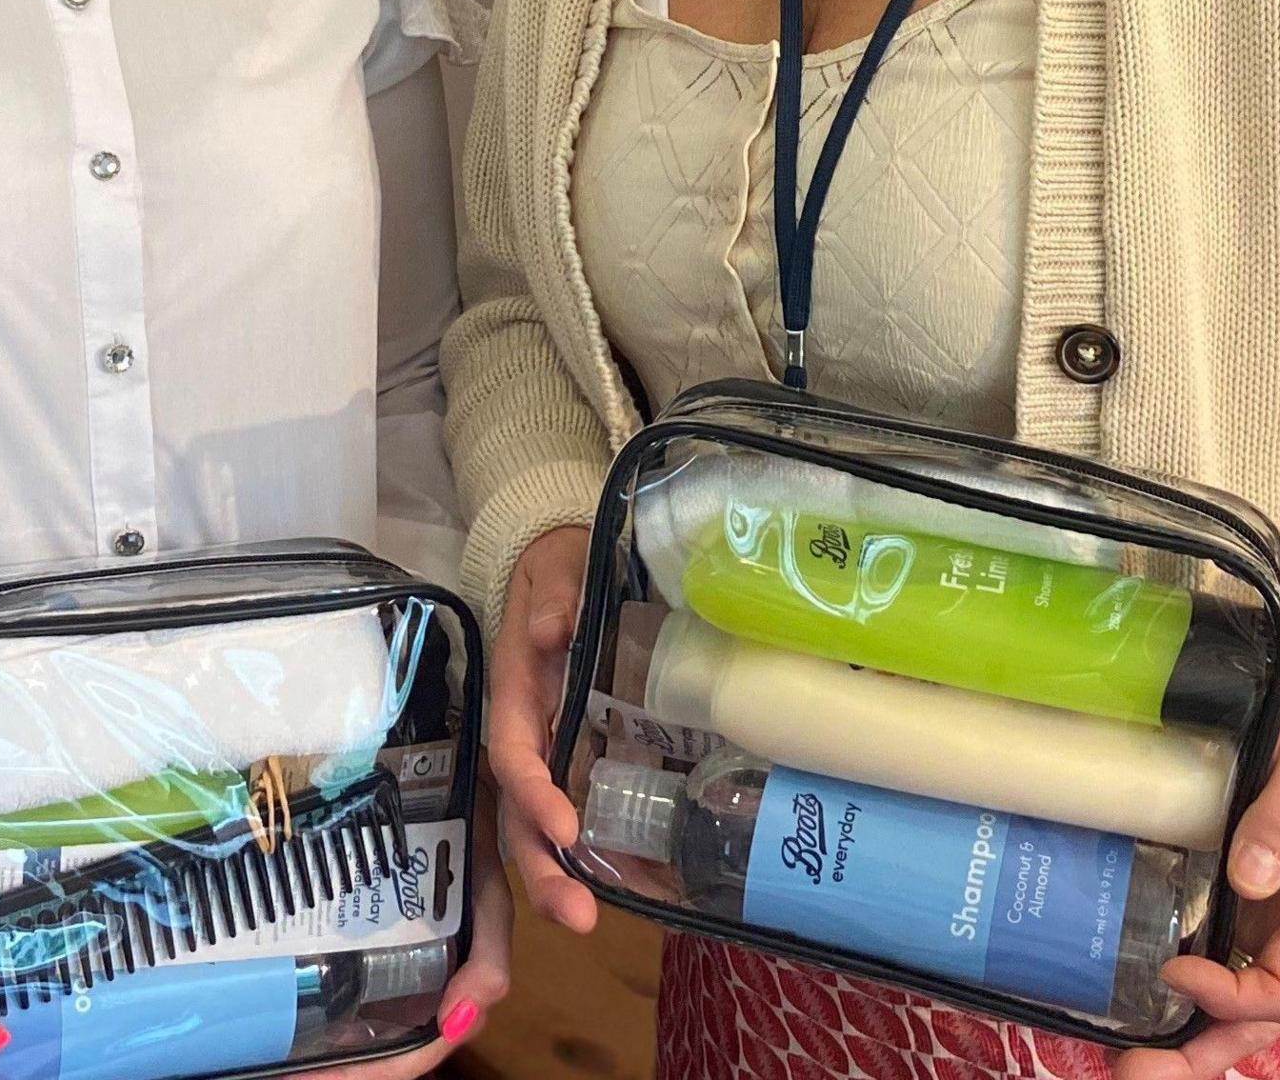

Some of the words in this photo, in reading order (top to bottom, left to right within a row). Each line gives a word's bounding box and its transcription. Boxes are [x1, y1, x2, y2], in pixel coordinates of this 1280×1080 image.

[781, 792, 828, 885] Boots
[832, 801, 862, 883] everyday
[1019, 840, 1035, 853] &
[950, 812, 997, 940] Shampoo
[1007, 854, 1033, 924] Coconut
[1027, 854, 1052, 919] Almond
[1089, 935, 1105, 960] 500
